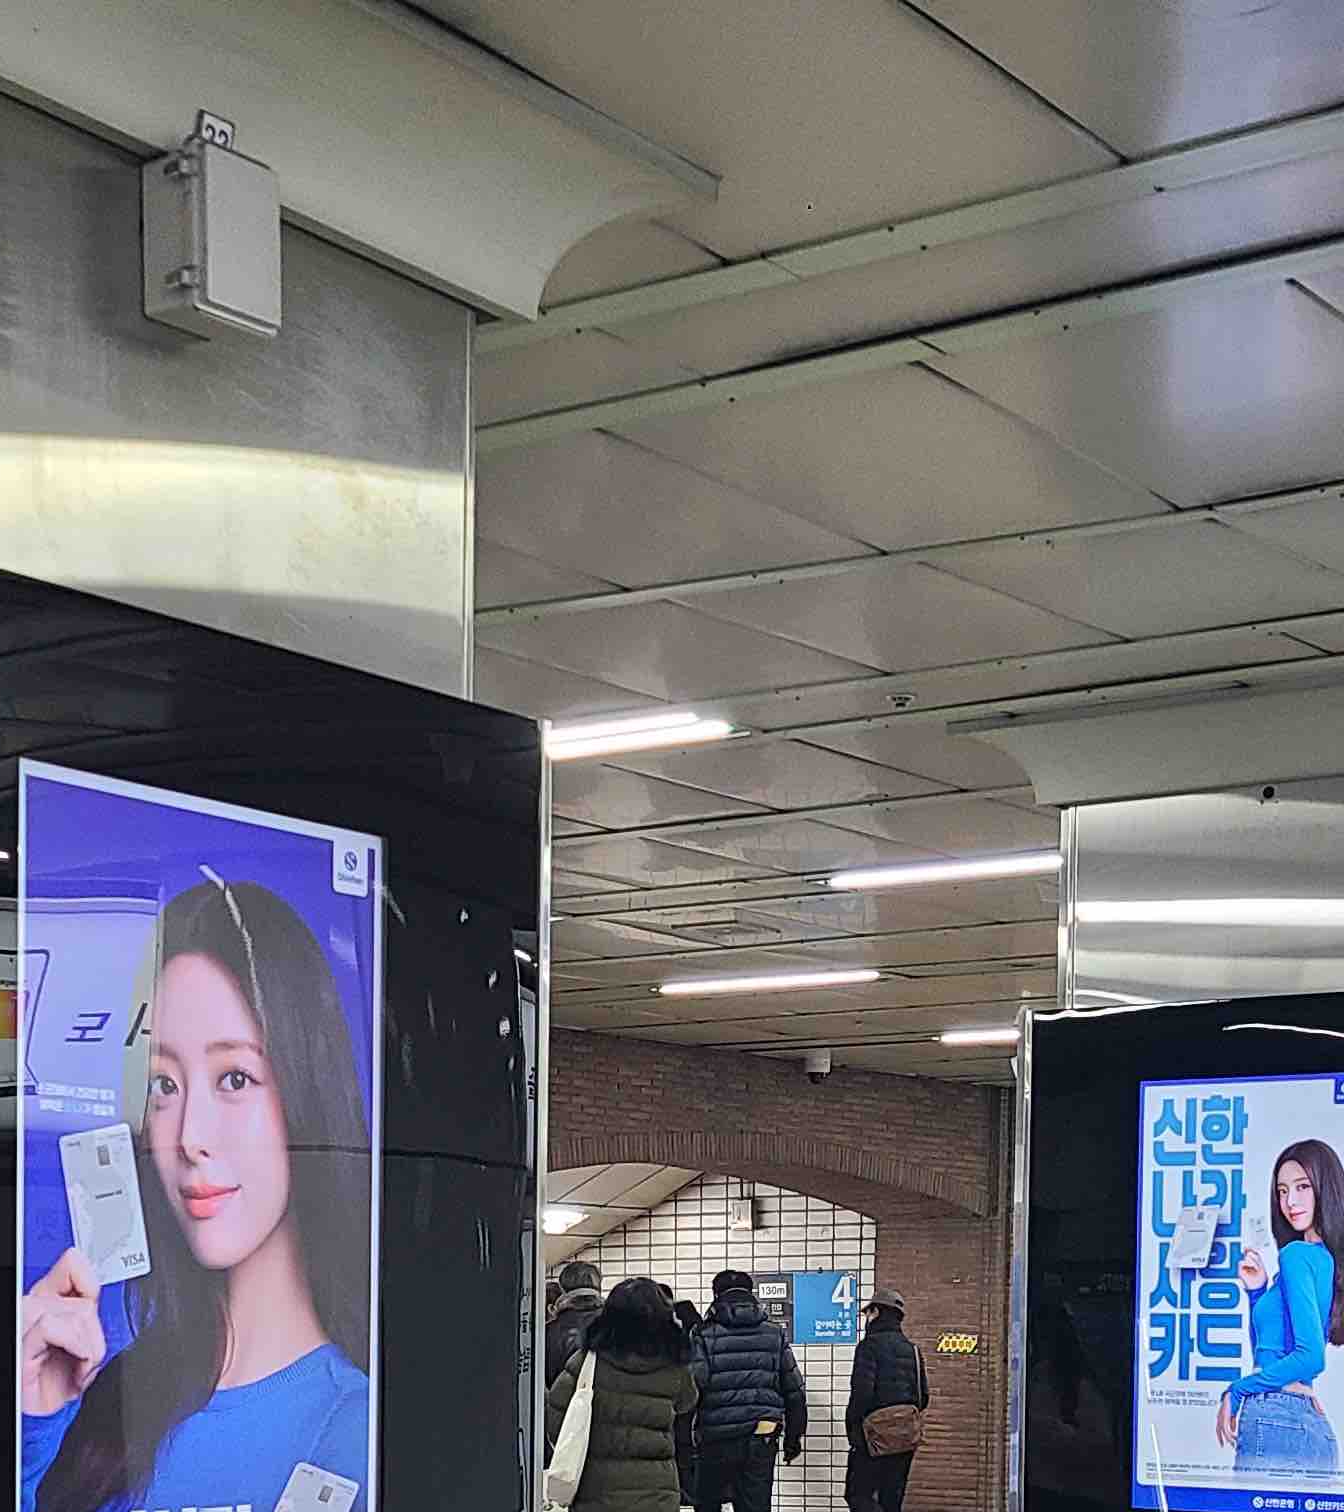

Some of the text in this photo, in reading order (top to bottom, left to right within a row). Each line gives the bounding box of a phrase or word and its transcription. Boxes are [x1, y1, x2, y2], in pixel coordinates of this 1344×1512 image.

[1152, 1095, 1248, 1166] 신한
[121, 1251, 145, 1268] VISA
[761, 1286, 785, 1295] 130m
[831, 1274, 855, 1310] 4
[1148, 1313, 1242, 1381] 카드
